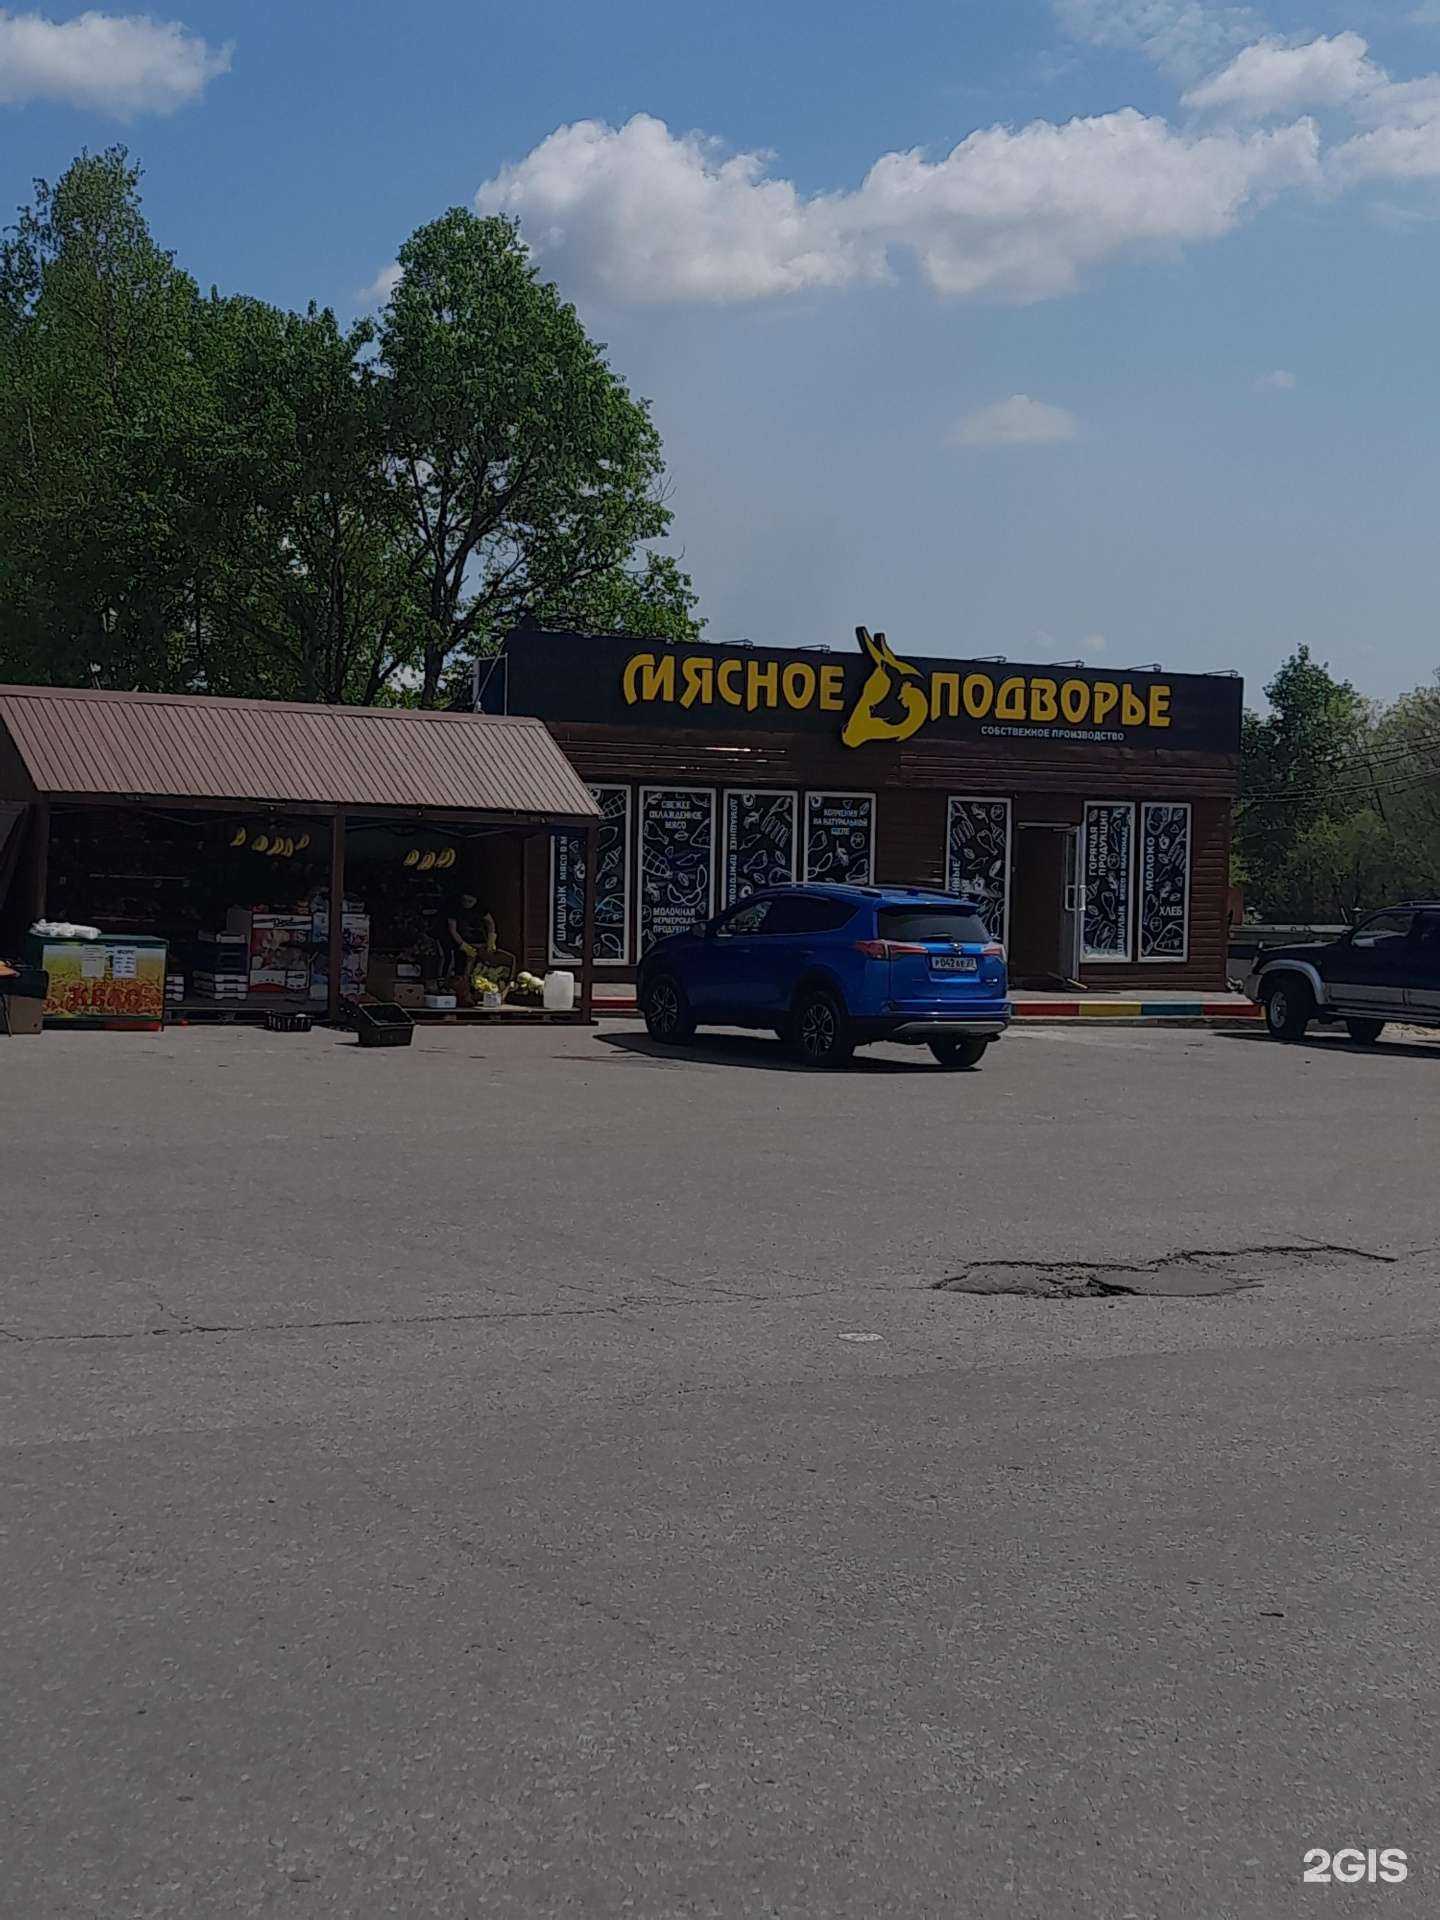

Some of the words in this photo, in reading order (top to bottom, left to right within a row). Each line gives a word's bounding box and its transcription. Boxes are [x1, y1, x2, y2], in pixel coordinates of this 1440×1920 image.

[622, 652, 845, 712] МЯСНОЕ
[928, 671, 1174, 729] ПОДВОРЬЕ
[981, 725, 1050, 738] СОБСТВЕННОЕ
[1051, 729, 1125, 742] ПРОИЗВОДСТВО
[1088, 825, 1099, 876] ГОРЯЧАЯ
[1145, 836, 1156, 892] МОЛОКО
[556, 885, 567, 942] ШАШЛЫК
[1117, 904, 1127, 954] ШАШЛЫК
[1158, 904, 1183, 916] ХЛЕБ
